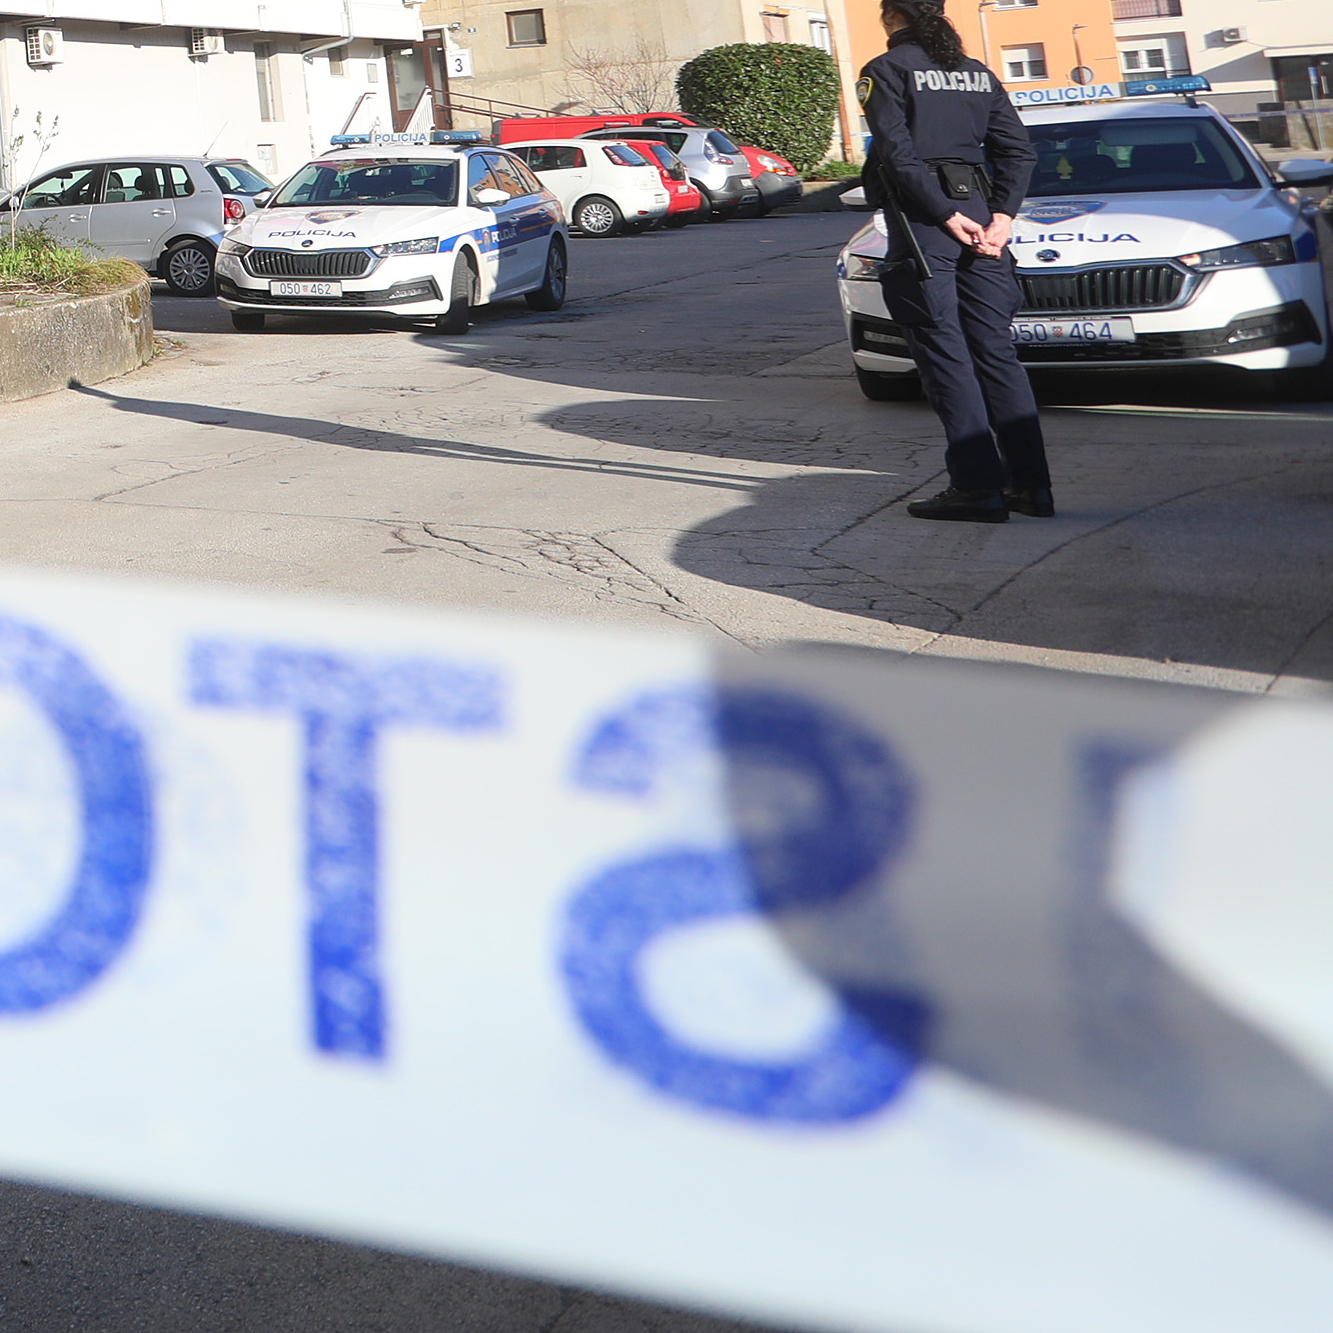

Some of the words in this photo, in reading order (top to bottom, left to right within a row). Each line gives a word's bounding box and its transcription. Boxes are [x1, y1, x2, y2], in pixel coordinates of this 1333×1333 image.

[454, 58, 464, 73] 3
[913, 69, 992, 93] POLICIJA
[1015, 85, 1115, 104] POLICIJA
[374, 133, 428, 143] POLICIJA
[268, 229, 357, 238] POLICIJA
[280, 283, 301, 294] 050
[310, 283, 332, 295] 462
[1069, 322, 1112, 340] 464
